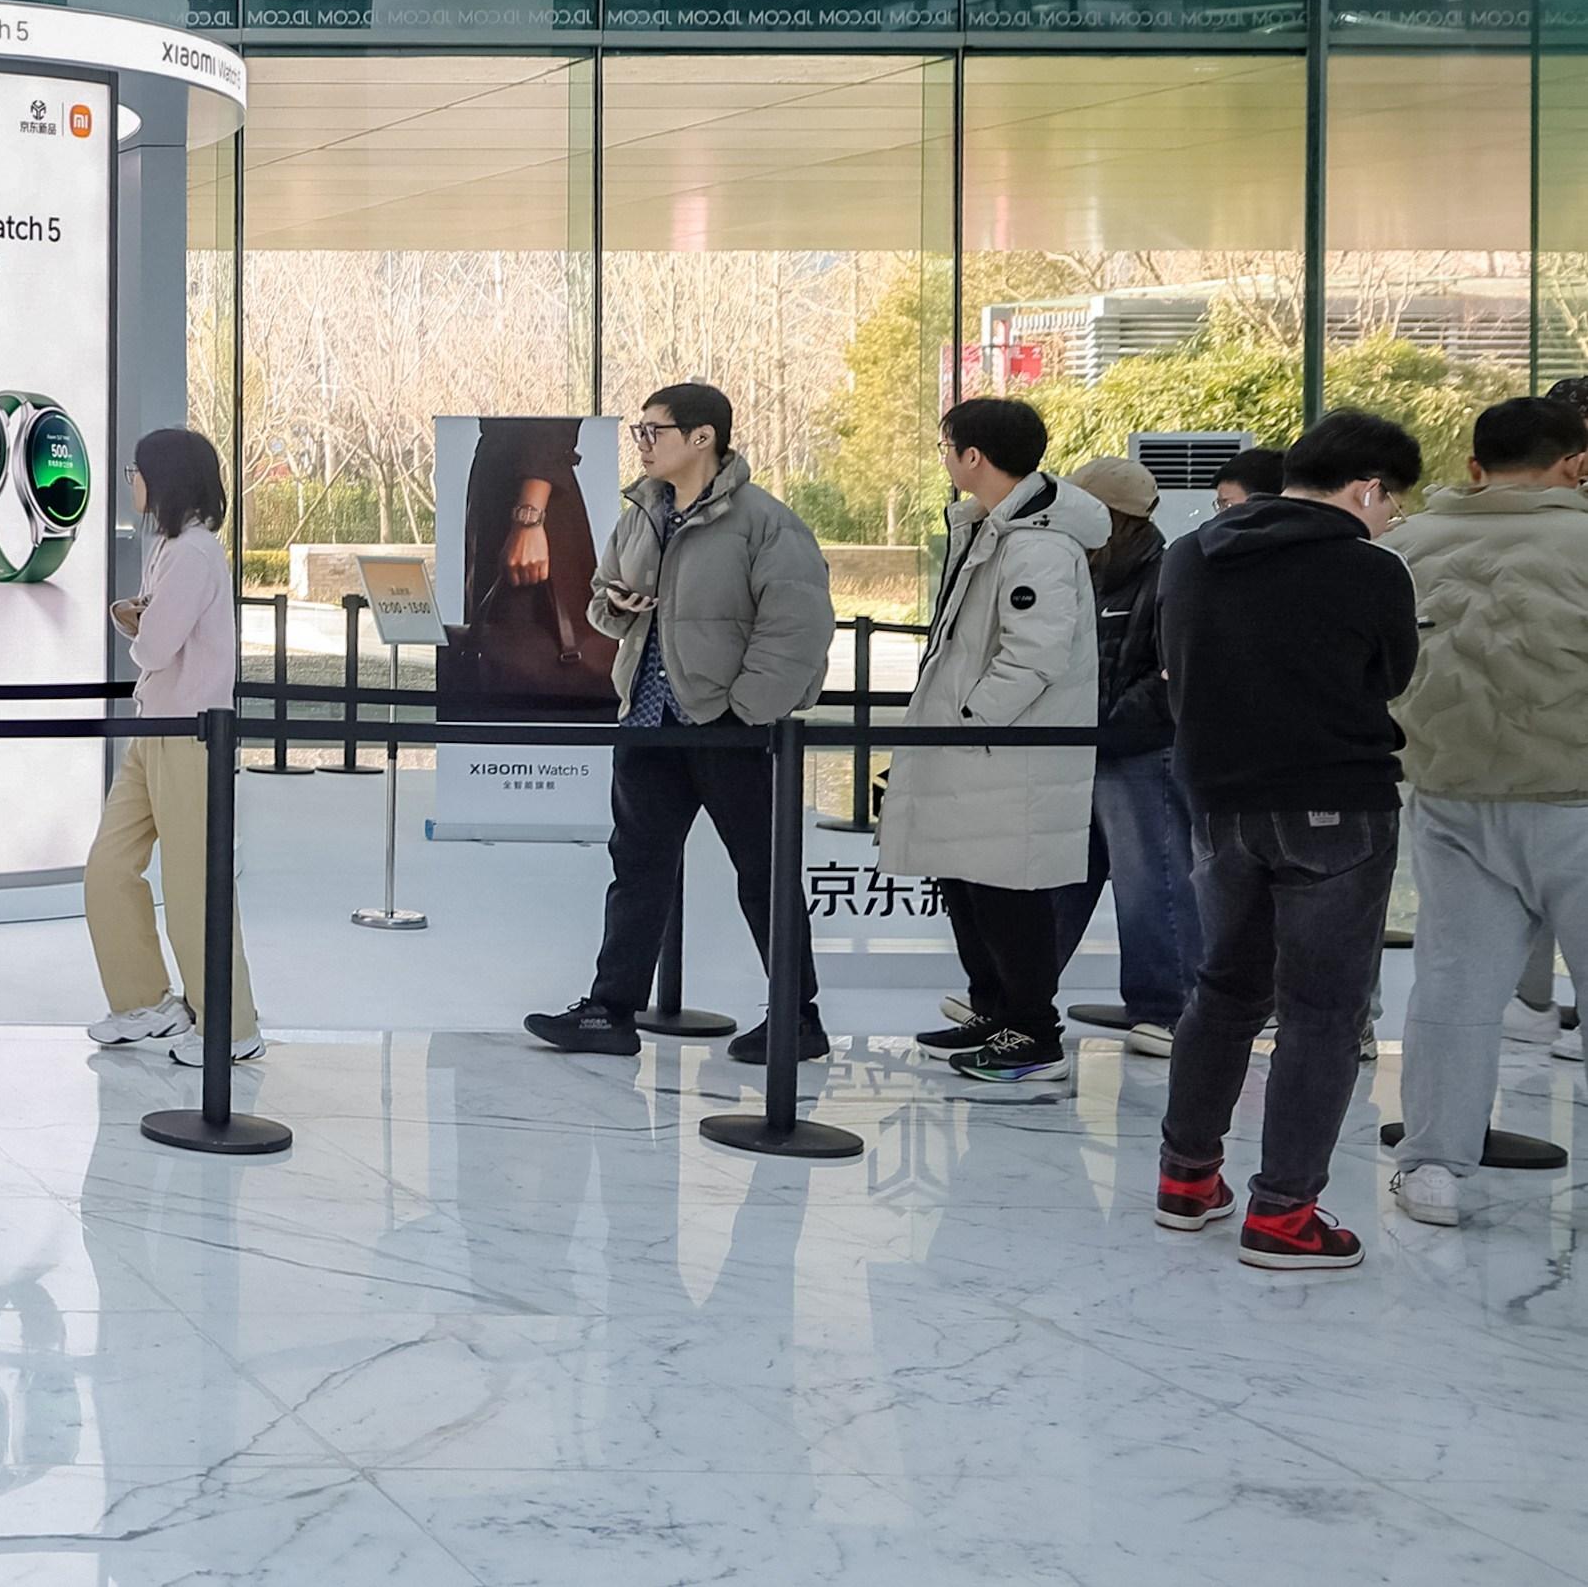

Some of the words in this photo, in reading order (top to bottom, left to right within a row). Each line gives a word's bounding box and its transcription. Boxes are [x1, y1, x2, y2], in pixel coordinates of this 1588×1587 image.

[17, 21, 28, 41] 5
[20, 121, 56, 135] 京东新品
[48, 217, 60, 242] 5
[51, 443, 68, 458] 500
[538, 765, 578, 776] Watch
[581, 765, 589, 776] 5
[806, 862, 949, 917] 京东
